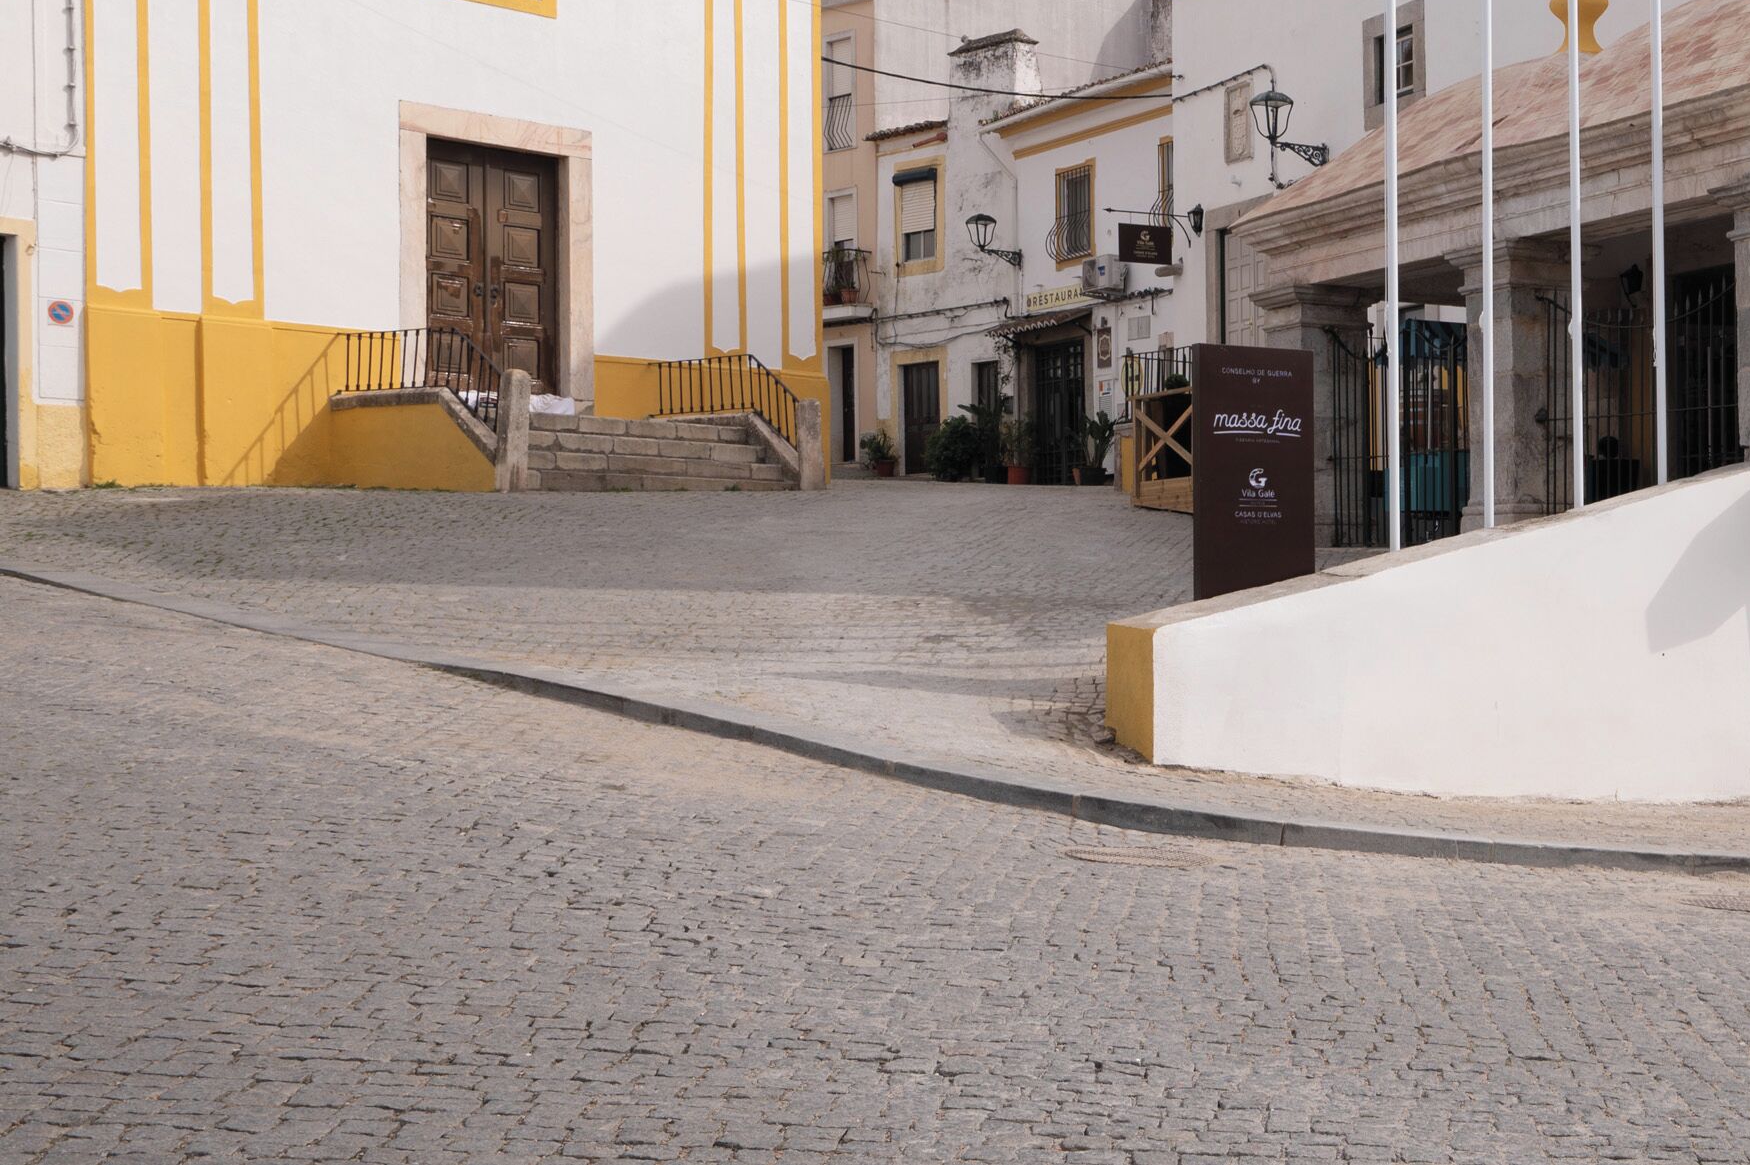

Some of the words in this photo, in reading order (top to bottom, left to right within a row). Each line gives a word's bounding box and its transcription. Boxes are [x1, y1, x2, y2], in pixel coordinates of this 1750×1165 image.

[1221, 367, 1255, 376] CONSELHO
[1213, 412, 1268, 428] massa
[1267, 409, 1301, 434] fina
[1241, 489, 1256, 498] Vila
[1258, 488, 1275, 498] Galé
[1234, 510, 1256, 518] CASAS
